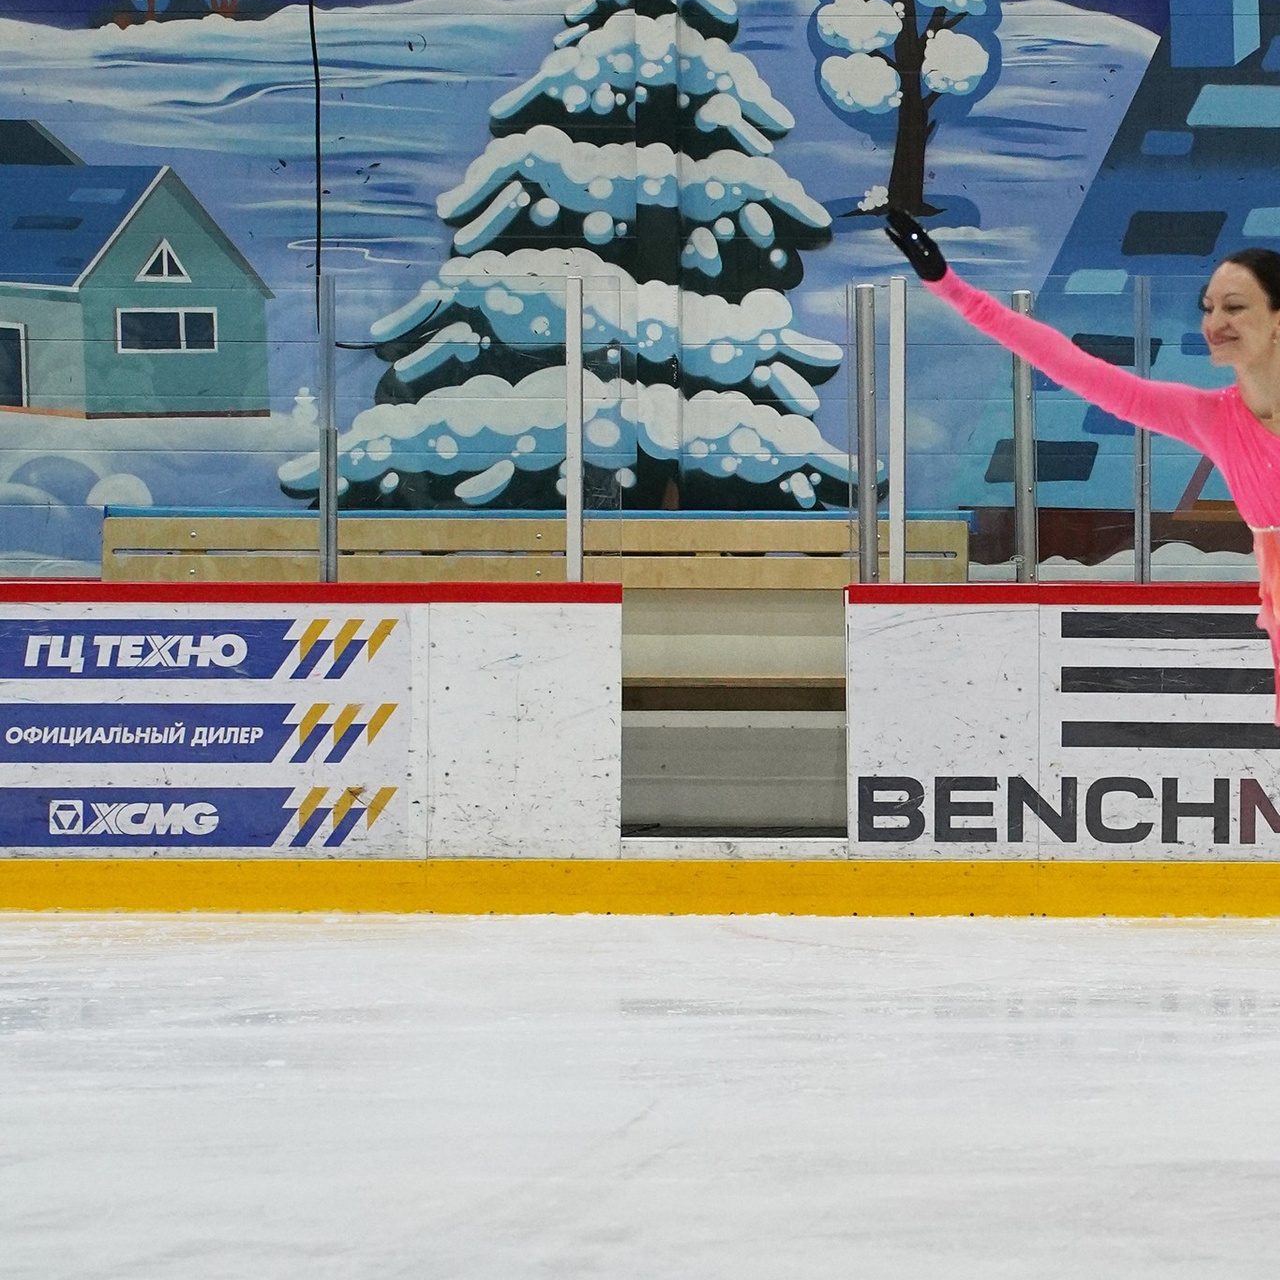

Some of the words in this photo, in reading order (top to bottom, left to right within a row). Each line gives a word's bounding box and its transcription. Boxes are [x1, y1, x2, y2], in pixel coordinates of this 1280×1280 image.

[24, 635, 84, 673] ГЦ
[93, 633, 248, 668] ТЕХНО
[5, 722, 186, 747] ОФИЦИАЛЬНЫЙ
[190, 726, 264, 747] ДИЛЕР
[83, 802, 220, 835] XCMG
